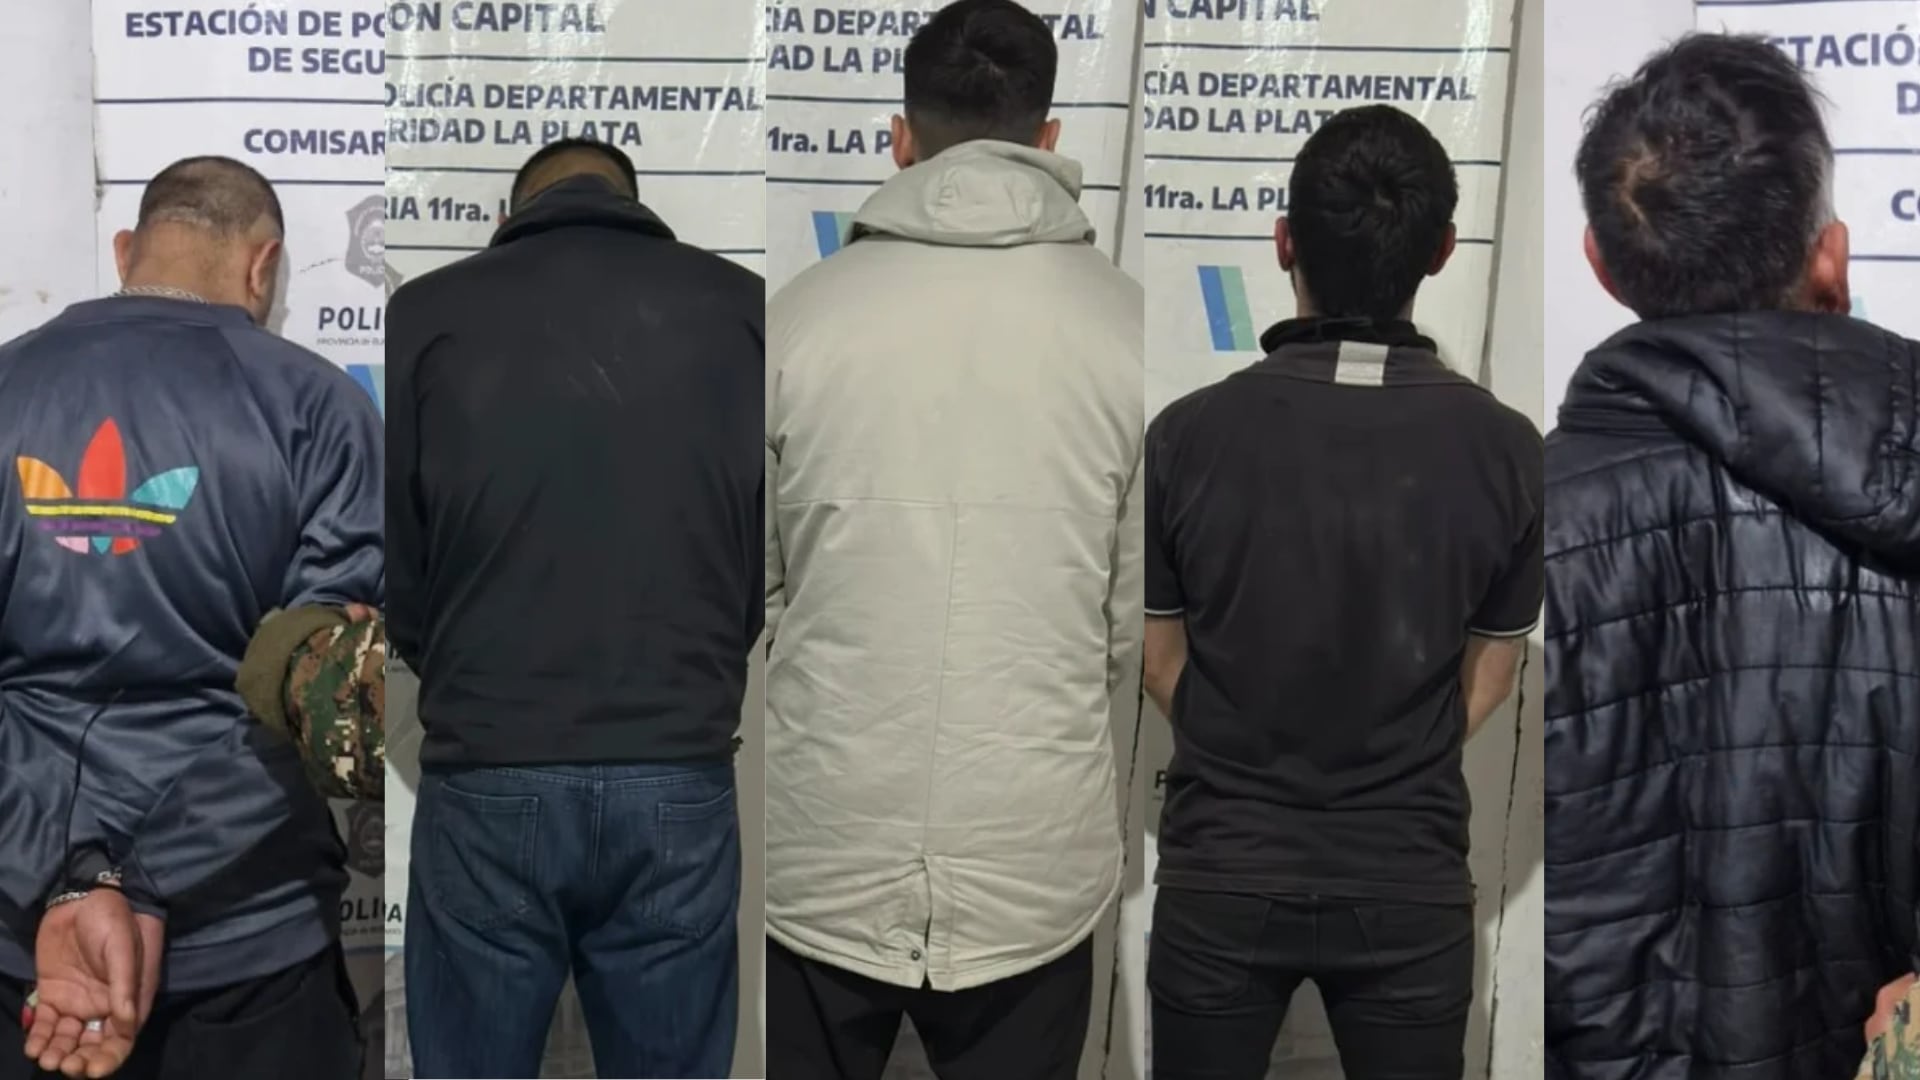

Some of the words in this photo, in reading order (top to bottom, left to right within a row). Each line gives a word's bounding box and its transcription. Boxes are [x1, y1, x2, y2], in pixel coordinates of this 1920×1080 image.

[126, 3, 288, 37] ESTACIÓN
[299, 11, 342, 36] DE
[452, 2, 606, 32] CAPITAL
[249, 47, 292, 72] DE
[302, 48, 385, 74] SEGU
[824, 46, 863, 73] LA
[484, 85, 764, 112] DEPARTAMENTAL
[1198, 72, 1477, 101] DEPARTAMENTAL
[494, 120, 531, 145] LA
[542, 120, 642, 146] PLATA
[1208, 108, 1246, 133] LA
[828, 129, 866, 154] LA
[428, 197, 490, 222] 11ra.
[1144, 184, 1204, 210] 11ra.
[1212, 186, 1249, 211] LA
[318, 306, 381, 330] POLI
